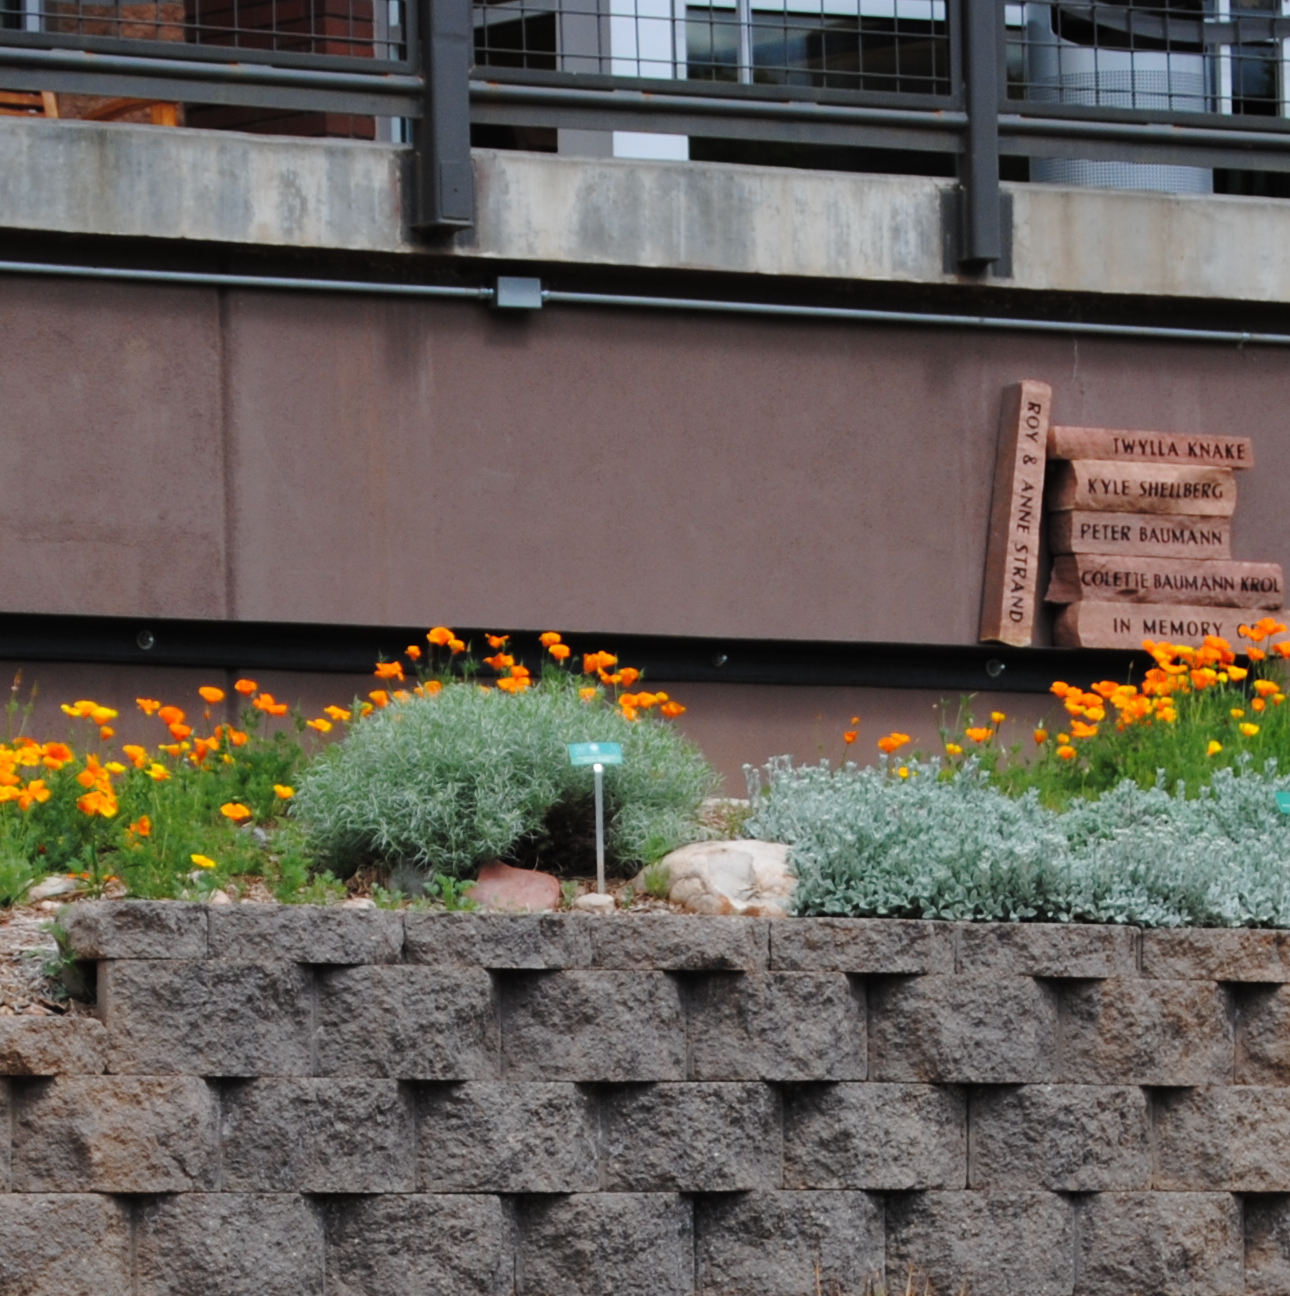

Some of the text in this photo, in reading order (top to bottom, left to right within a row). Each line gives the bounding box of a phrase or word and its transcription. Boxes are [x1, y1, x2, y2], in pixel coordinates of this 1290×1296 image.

[1112, 437, 1246, 460] TWYLLA KNAKE
[1088, 478, 1224, 500] KYLE SHELLBERG
[1009, 401, 1041, 623] ROY & ANNE STRAND
[1080, 523, 1223, 545] PETER BAUMANN
[1081, 570, 1280, 593] COLETTE BAUMANN KROL
[1113, 618, 1131, 633] IN
[1143, 619, 1223, 637] MEMORY
